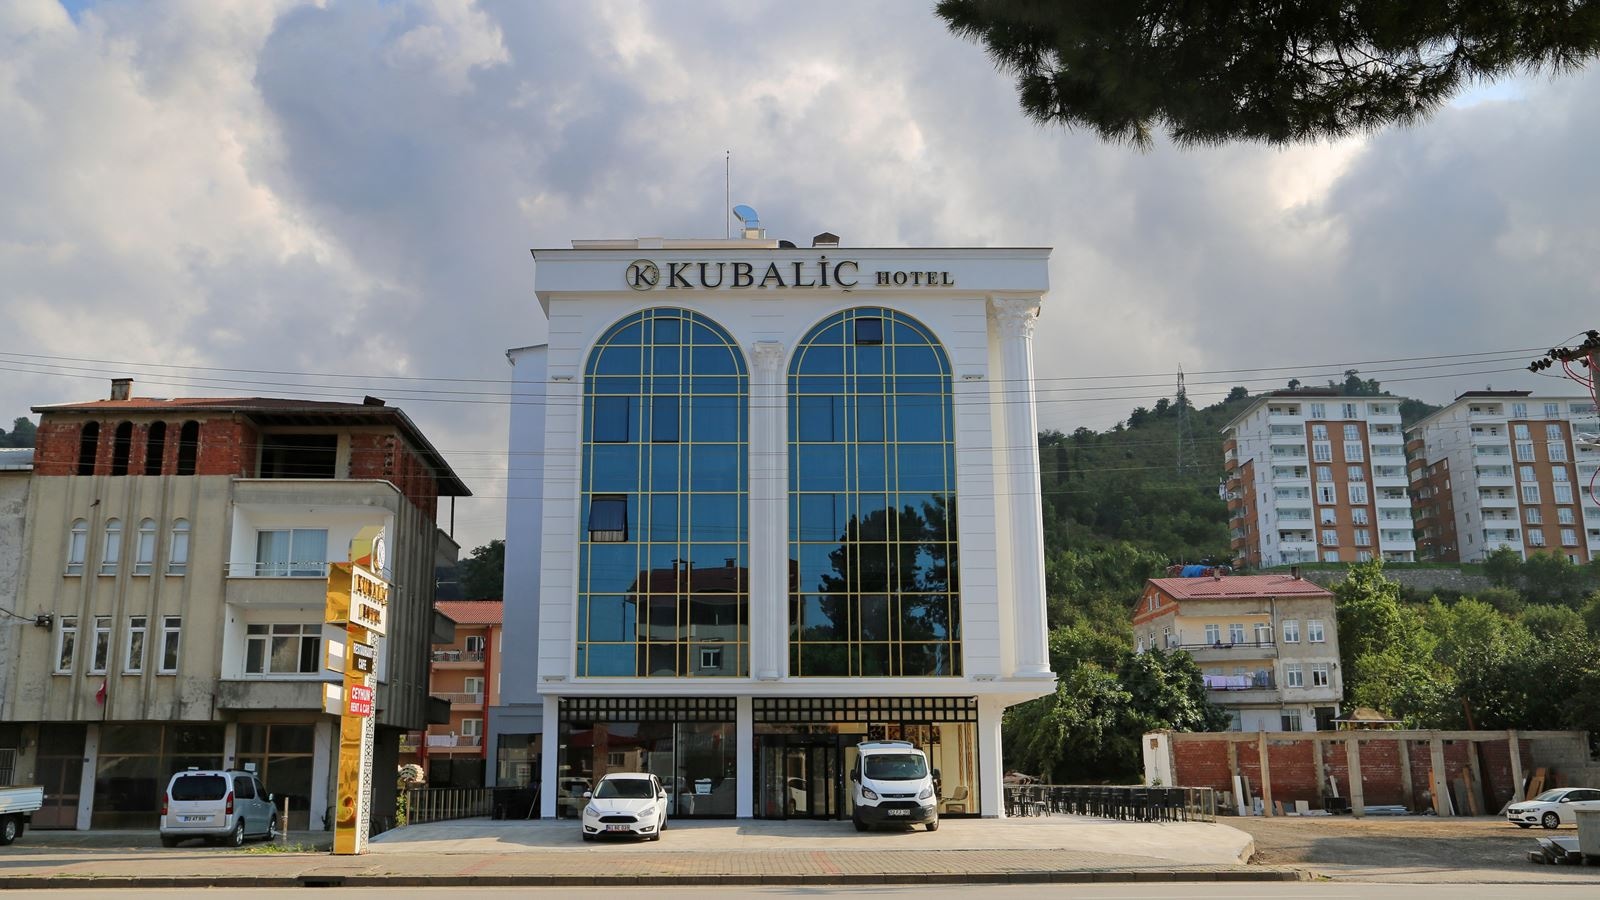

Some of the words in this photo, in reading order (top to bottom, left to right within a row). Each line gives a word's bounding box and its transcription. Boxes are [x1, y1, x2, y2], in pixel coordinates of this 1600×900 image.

[666, 255, 859, 293] KUBALİÇ
[876, 270, 955, 287] HOTEL
[351, 686, 371, 702] CEYHUN
[350, 702, 360, 713] RENT
[362, 703, 370, 714] CAR
